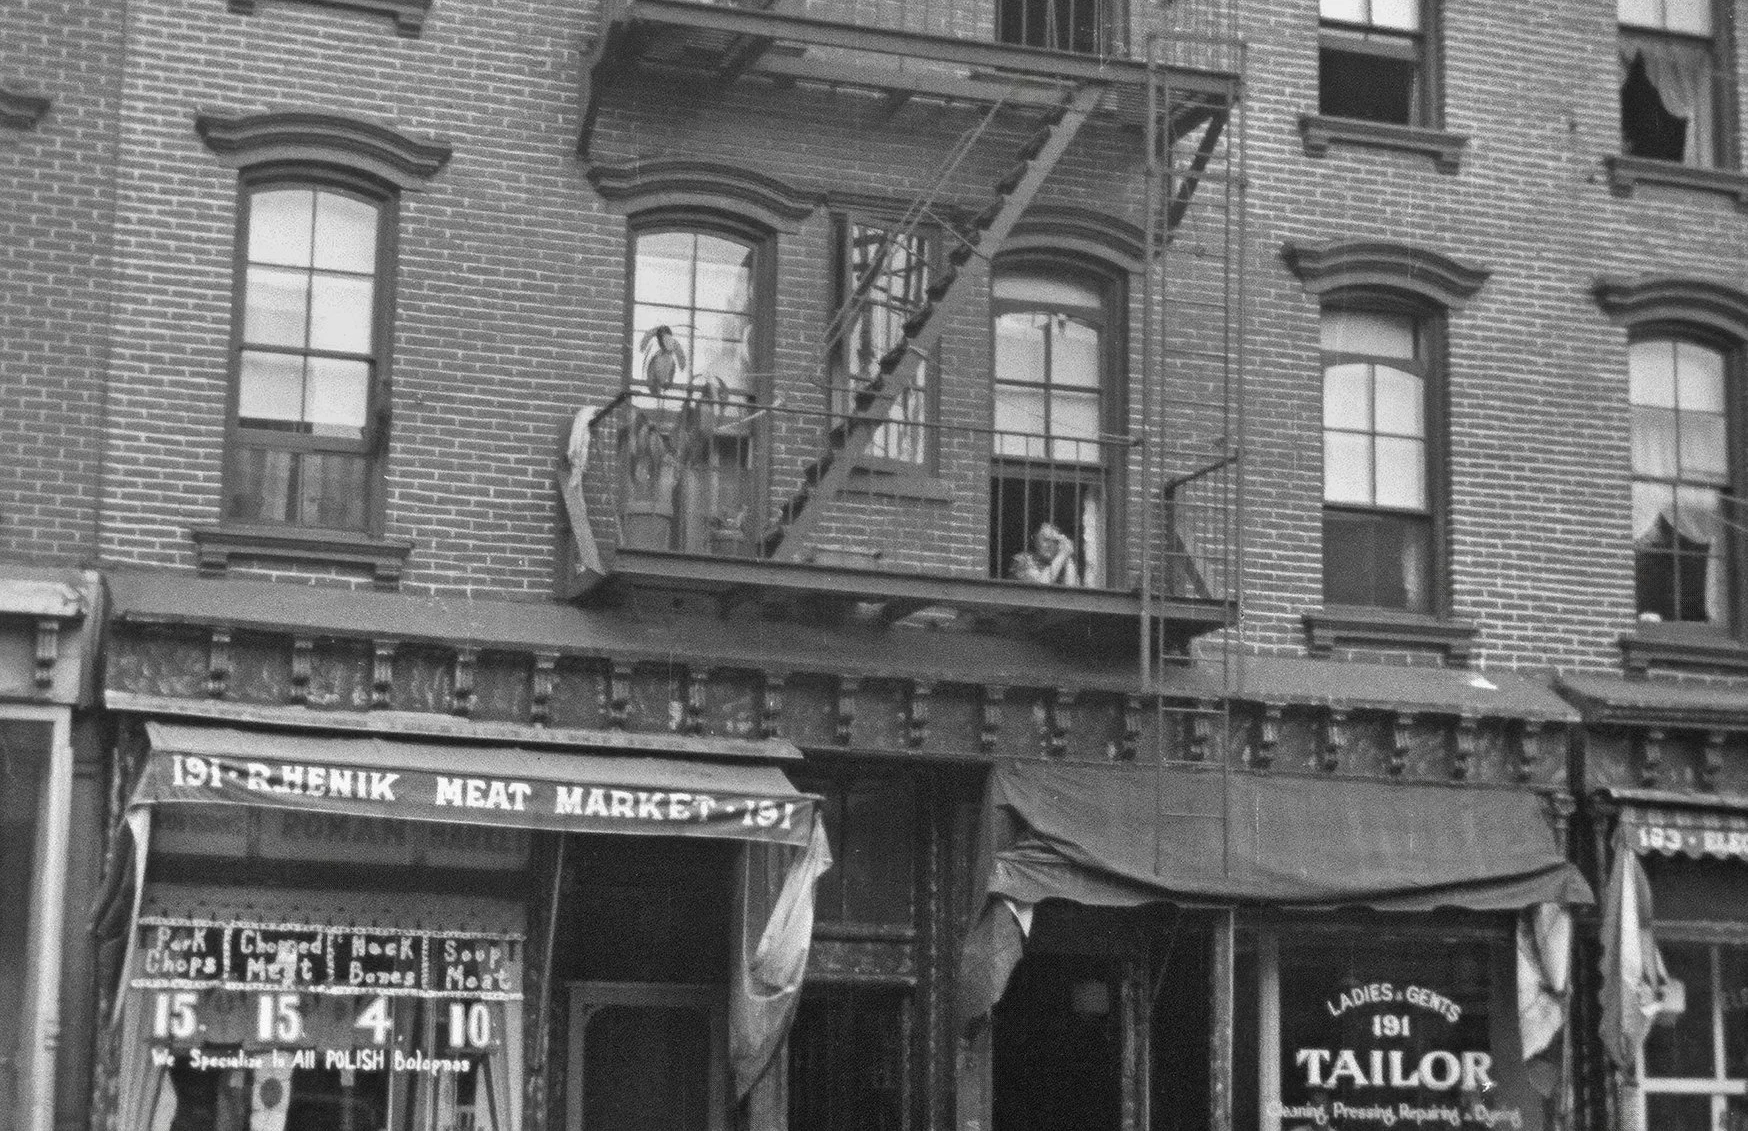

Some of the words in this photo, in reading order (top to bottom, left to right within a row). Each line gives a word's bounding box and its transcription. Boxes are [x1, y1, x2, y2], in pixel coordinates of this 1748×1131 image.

[172, 755, 222, 788] 191
[435, 776, 532, 811] MEAT
[554, 785, 716, 822] MARKET
[741, 798, 795, 830] 191
[145, 948, 217, 978] Chops
[349, 961, 416, 987] Bones
[444, 939, 501, 969] Soup
[153, 992, 198, 1038] 15
[257, 994, 302, 1042] 15
[354, 995, 394, 1045] 4
[1327, 983, 1393, 1017] LADIES
[1405, 985, 1462, 1023] GENTS
[449, 1001, 491, 1048] 10
[1372, 1014, 1411, 1037] 191
[290, 1048, 316, 1069] All
[325, 1048, 385, 1070] POLISH
[1296, 1048, 1497, 1092] TAILOR
